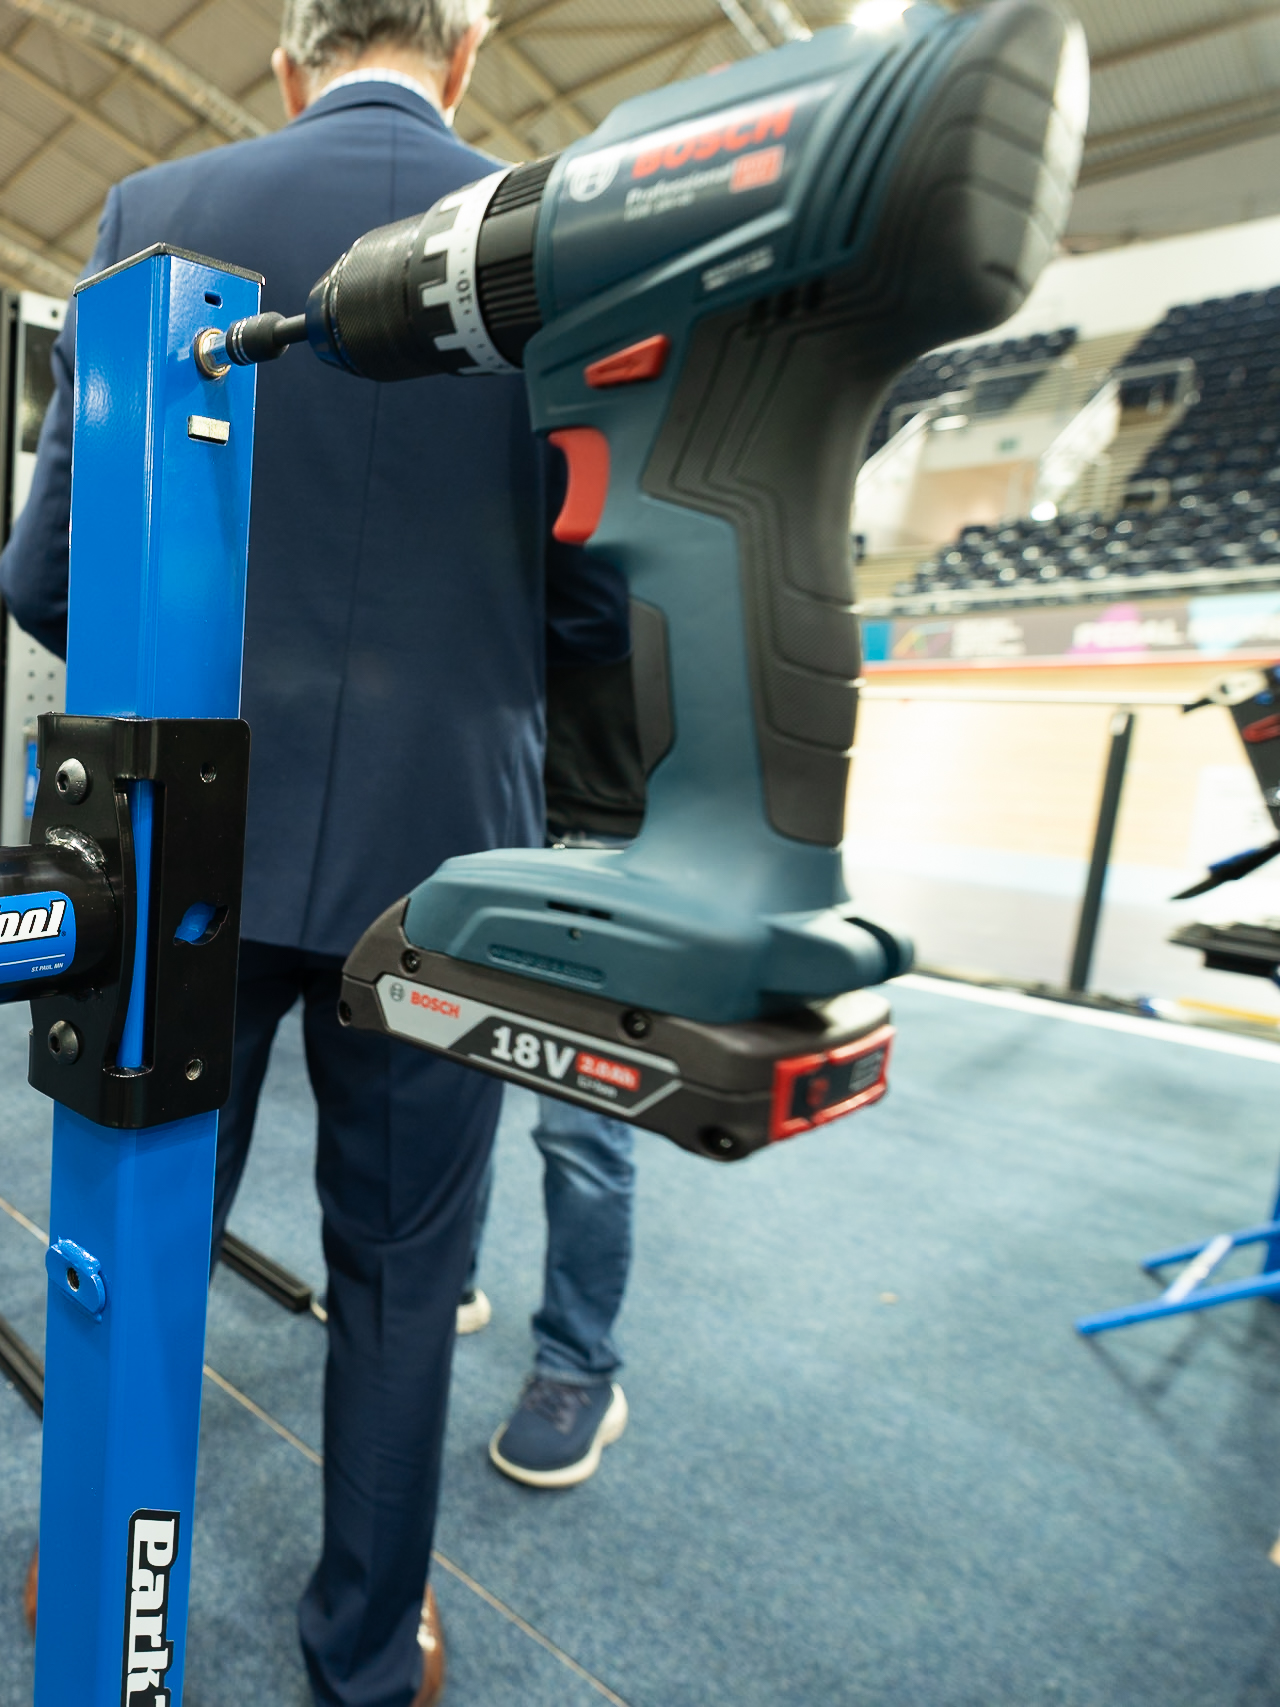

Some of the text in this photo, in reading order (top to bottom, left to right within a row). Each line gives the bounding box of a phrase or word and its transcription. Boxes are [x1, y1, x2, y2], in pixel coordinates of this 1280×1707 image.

[631, 101, 797, 180] BOSCH
[410, 990, 461, 1019] BOSCH
[490, 1025, 577, 1080] 18V
